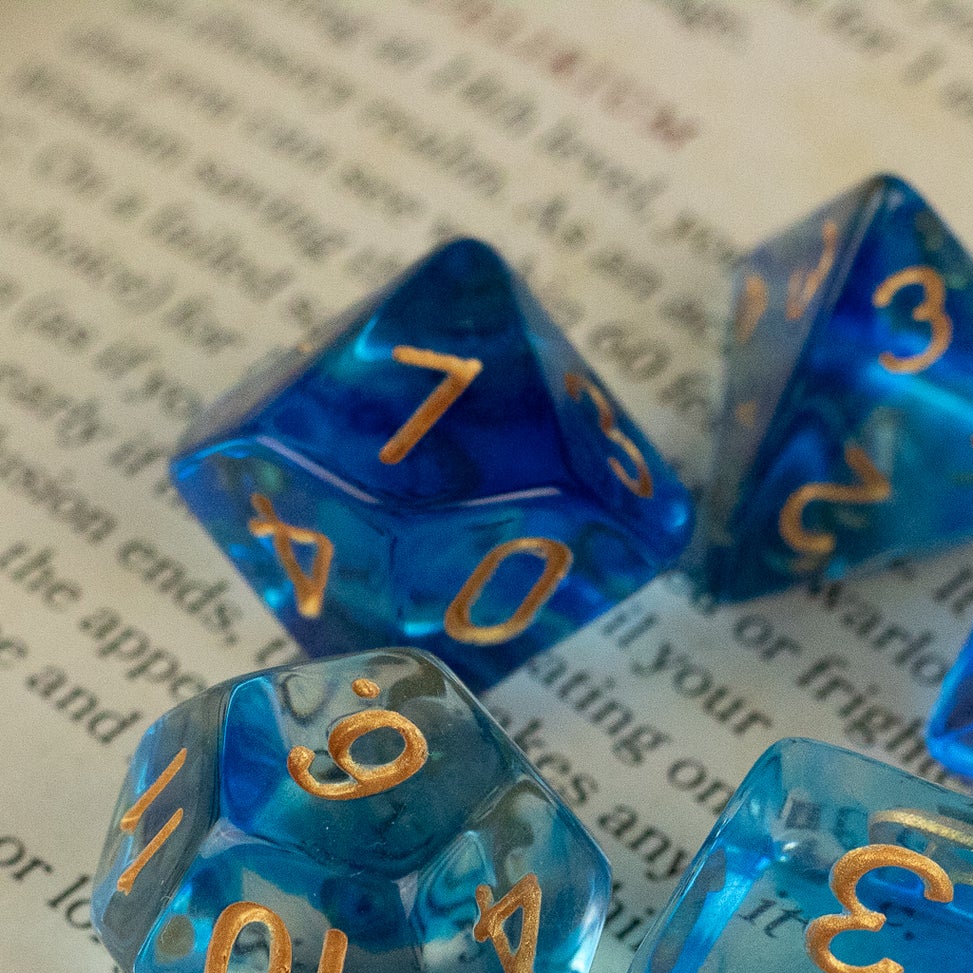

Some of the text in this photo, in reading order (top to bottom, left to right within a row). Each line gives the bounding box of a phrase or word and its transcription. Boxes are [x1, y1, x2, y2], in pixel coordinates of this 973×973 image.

[873, 265, 953, 375] 3
[377, 344, 483, 464] 7
[249, 493, 334, 618] 4
[444, 537, 573, 645] 0
[633, 641, 771, 734] your
